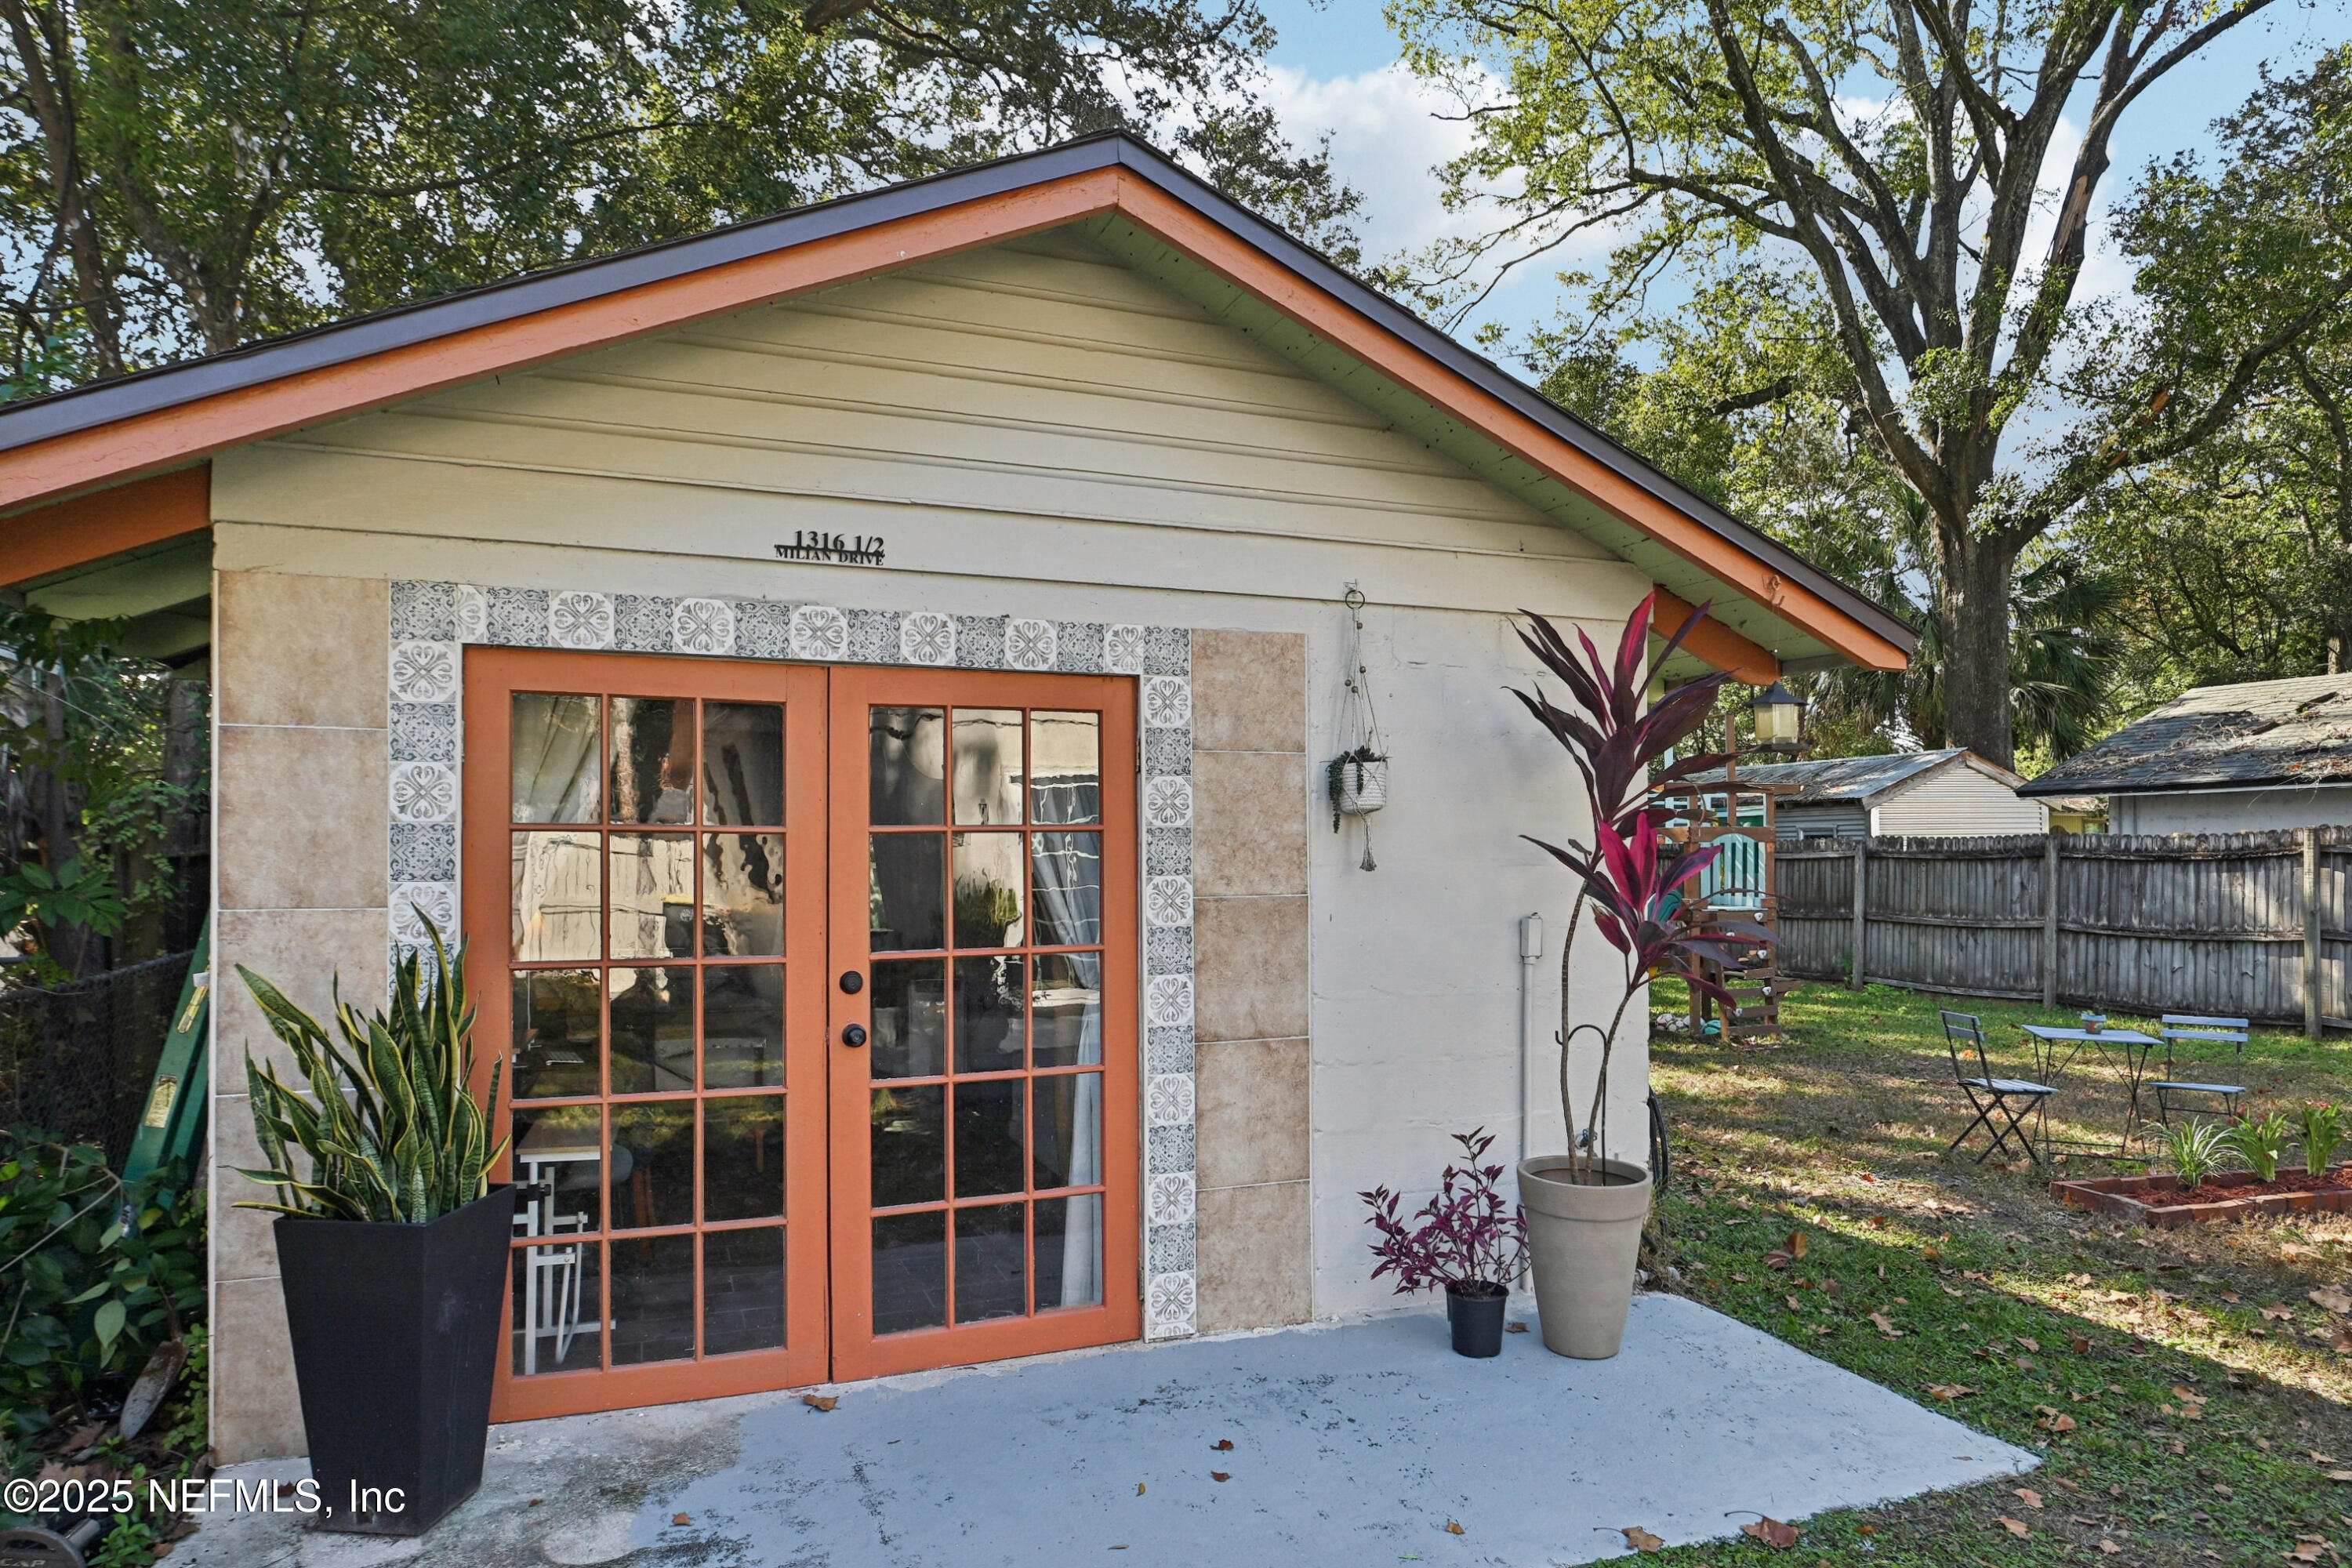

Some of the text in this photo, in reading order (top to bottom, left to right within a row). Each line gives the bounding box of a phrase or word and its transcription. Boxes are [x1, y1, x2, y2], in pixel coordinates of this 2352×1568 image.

[795, 530, 884, 555] 1316 1/2
[838, 552, 884, 565] DRIVE
[0, 1558, 45, 1567] CAP
